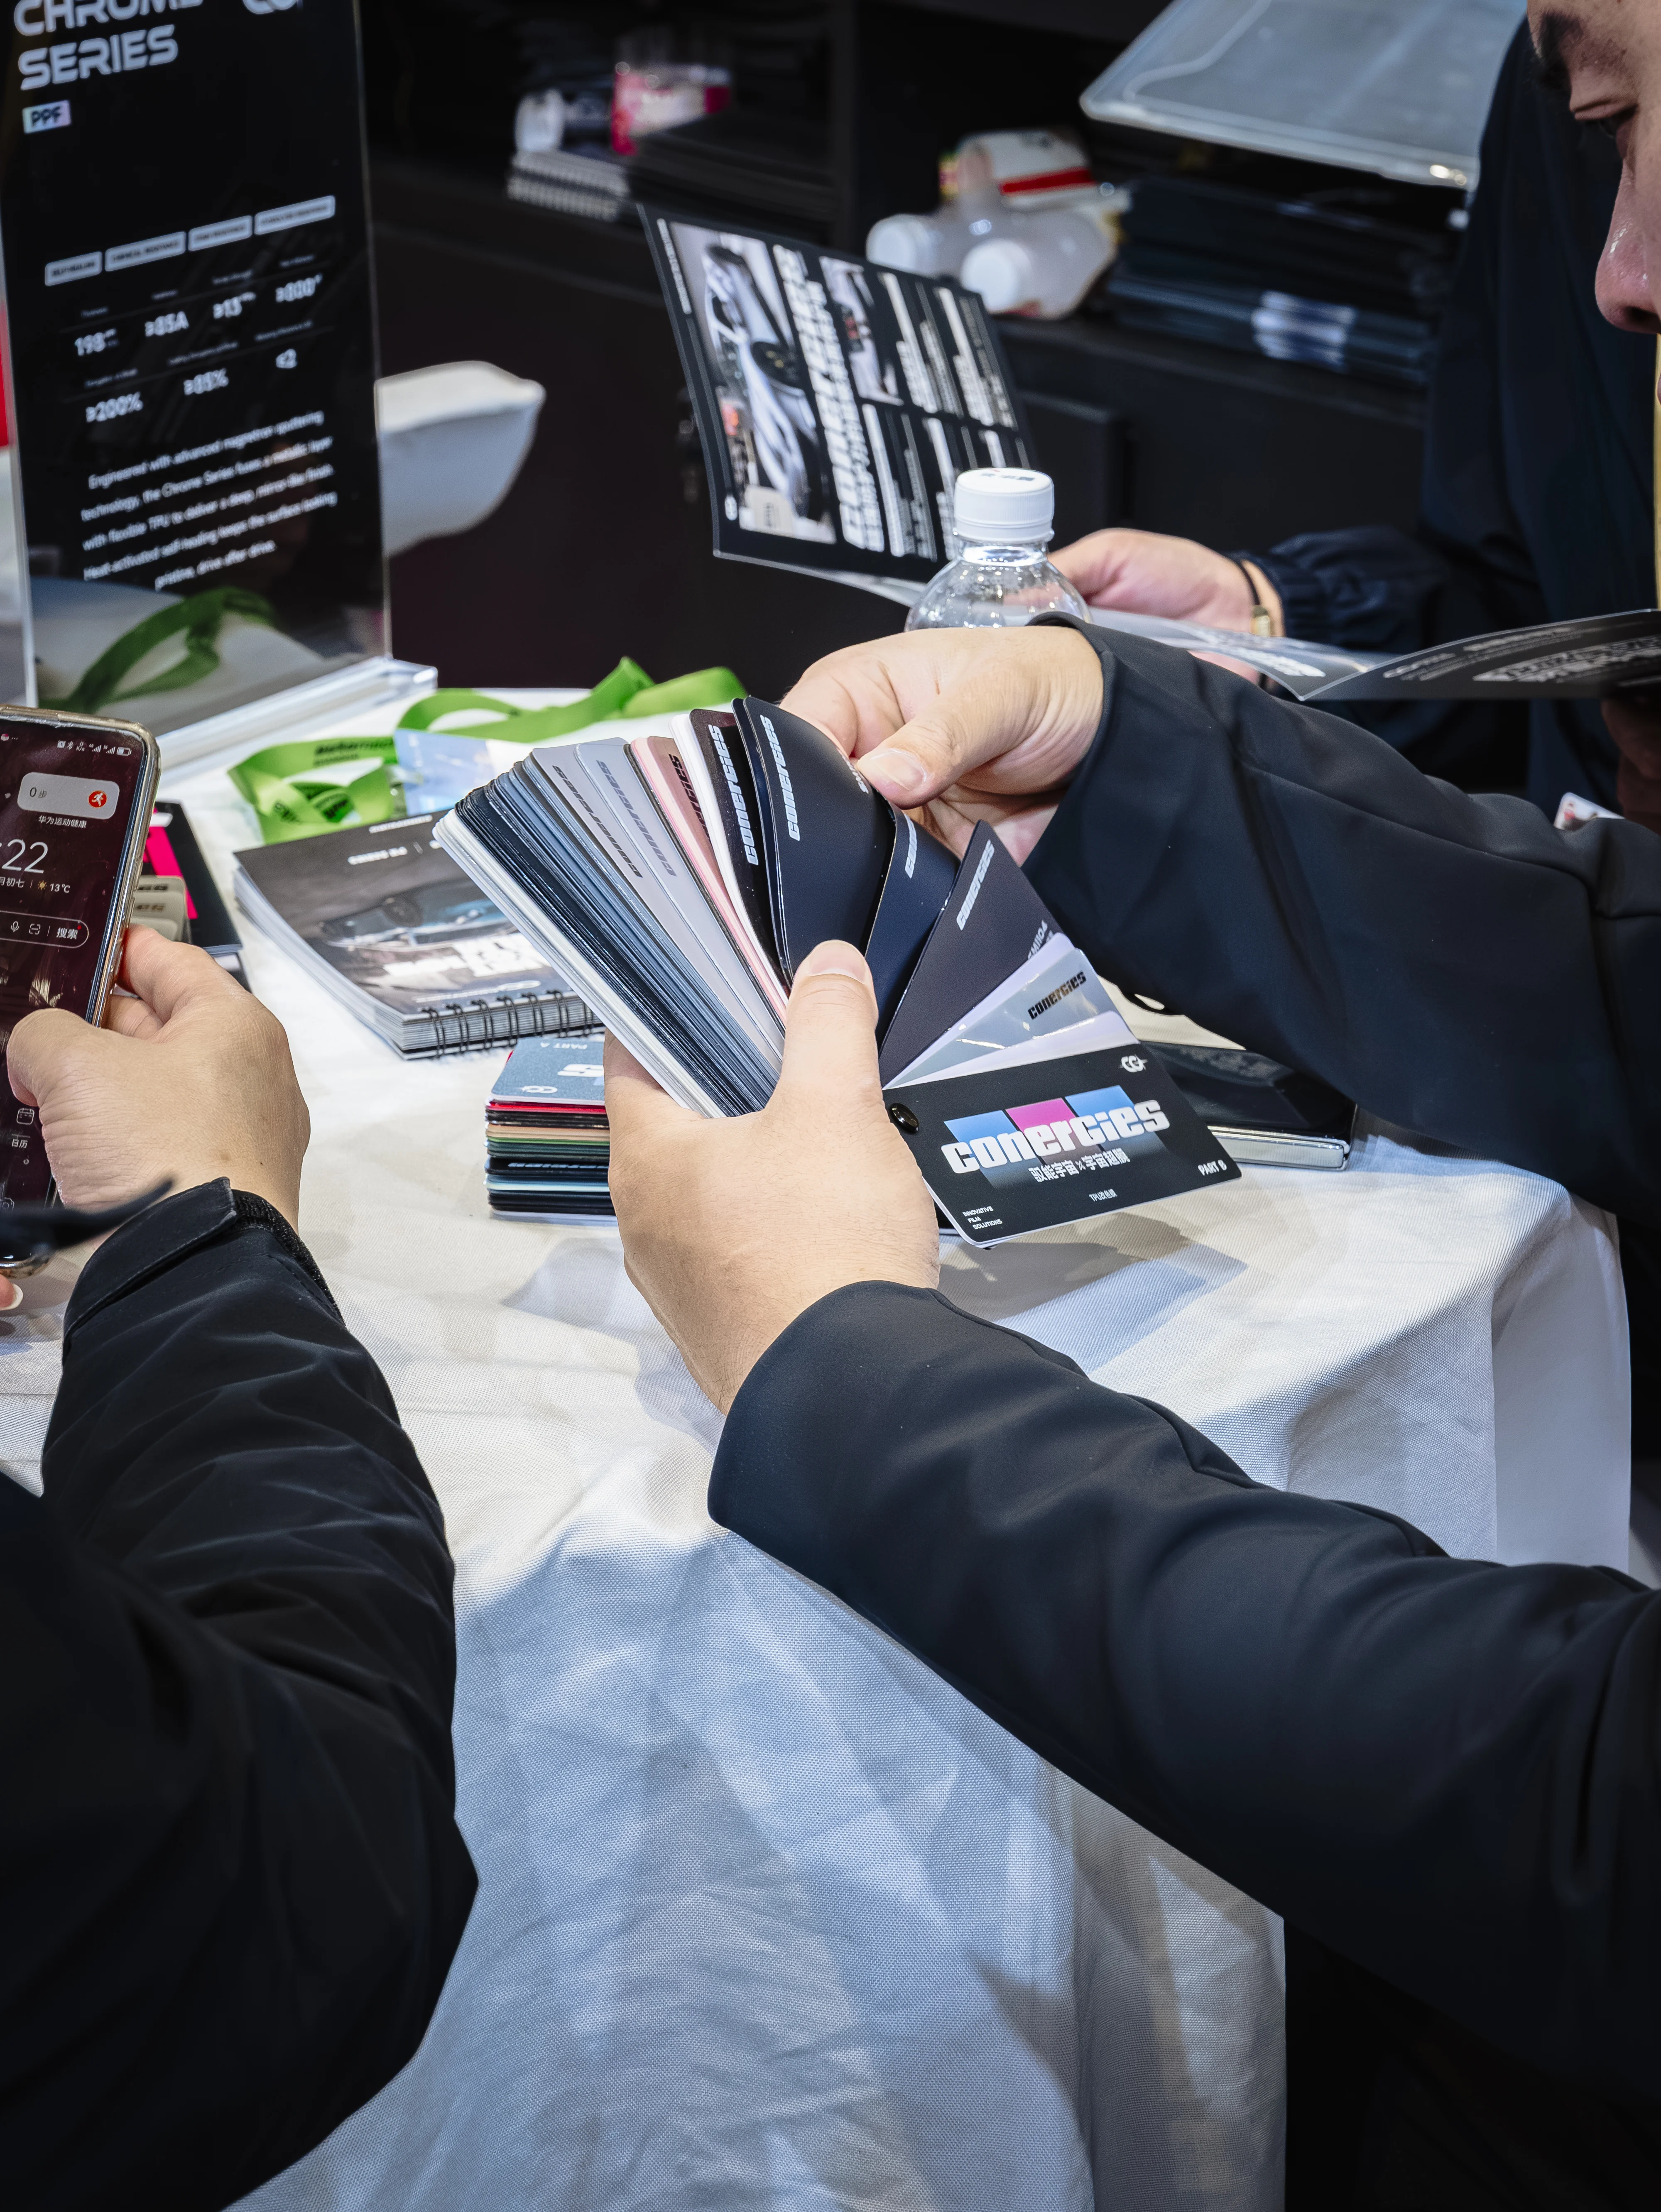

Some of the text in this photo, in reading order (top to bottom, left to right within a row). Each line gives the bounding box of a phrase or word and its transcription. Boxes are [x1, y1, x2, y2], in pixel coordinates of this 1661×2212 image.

[14, 0, 203, 36] CHRO
[18, 24, 178, 91] SERIES
[31, 107, 62, 127] PPF
[38, 815, 87, 829] 华为运动健康
[56, 927, 78, 940] 搜索
[11, 1138, 28, 1149] 日历
[1198, 1161, 1220, 1176] PART
[962, 1206, 994, 1217] INNOVATIVE
[967, 1216, 982, 1224] FILM
[972, 1219, 1003, 1230] SOLUTIONS
